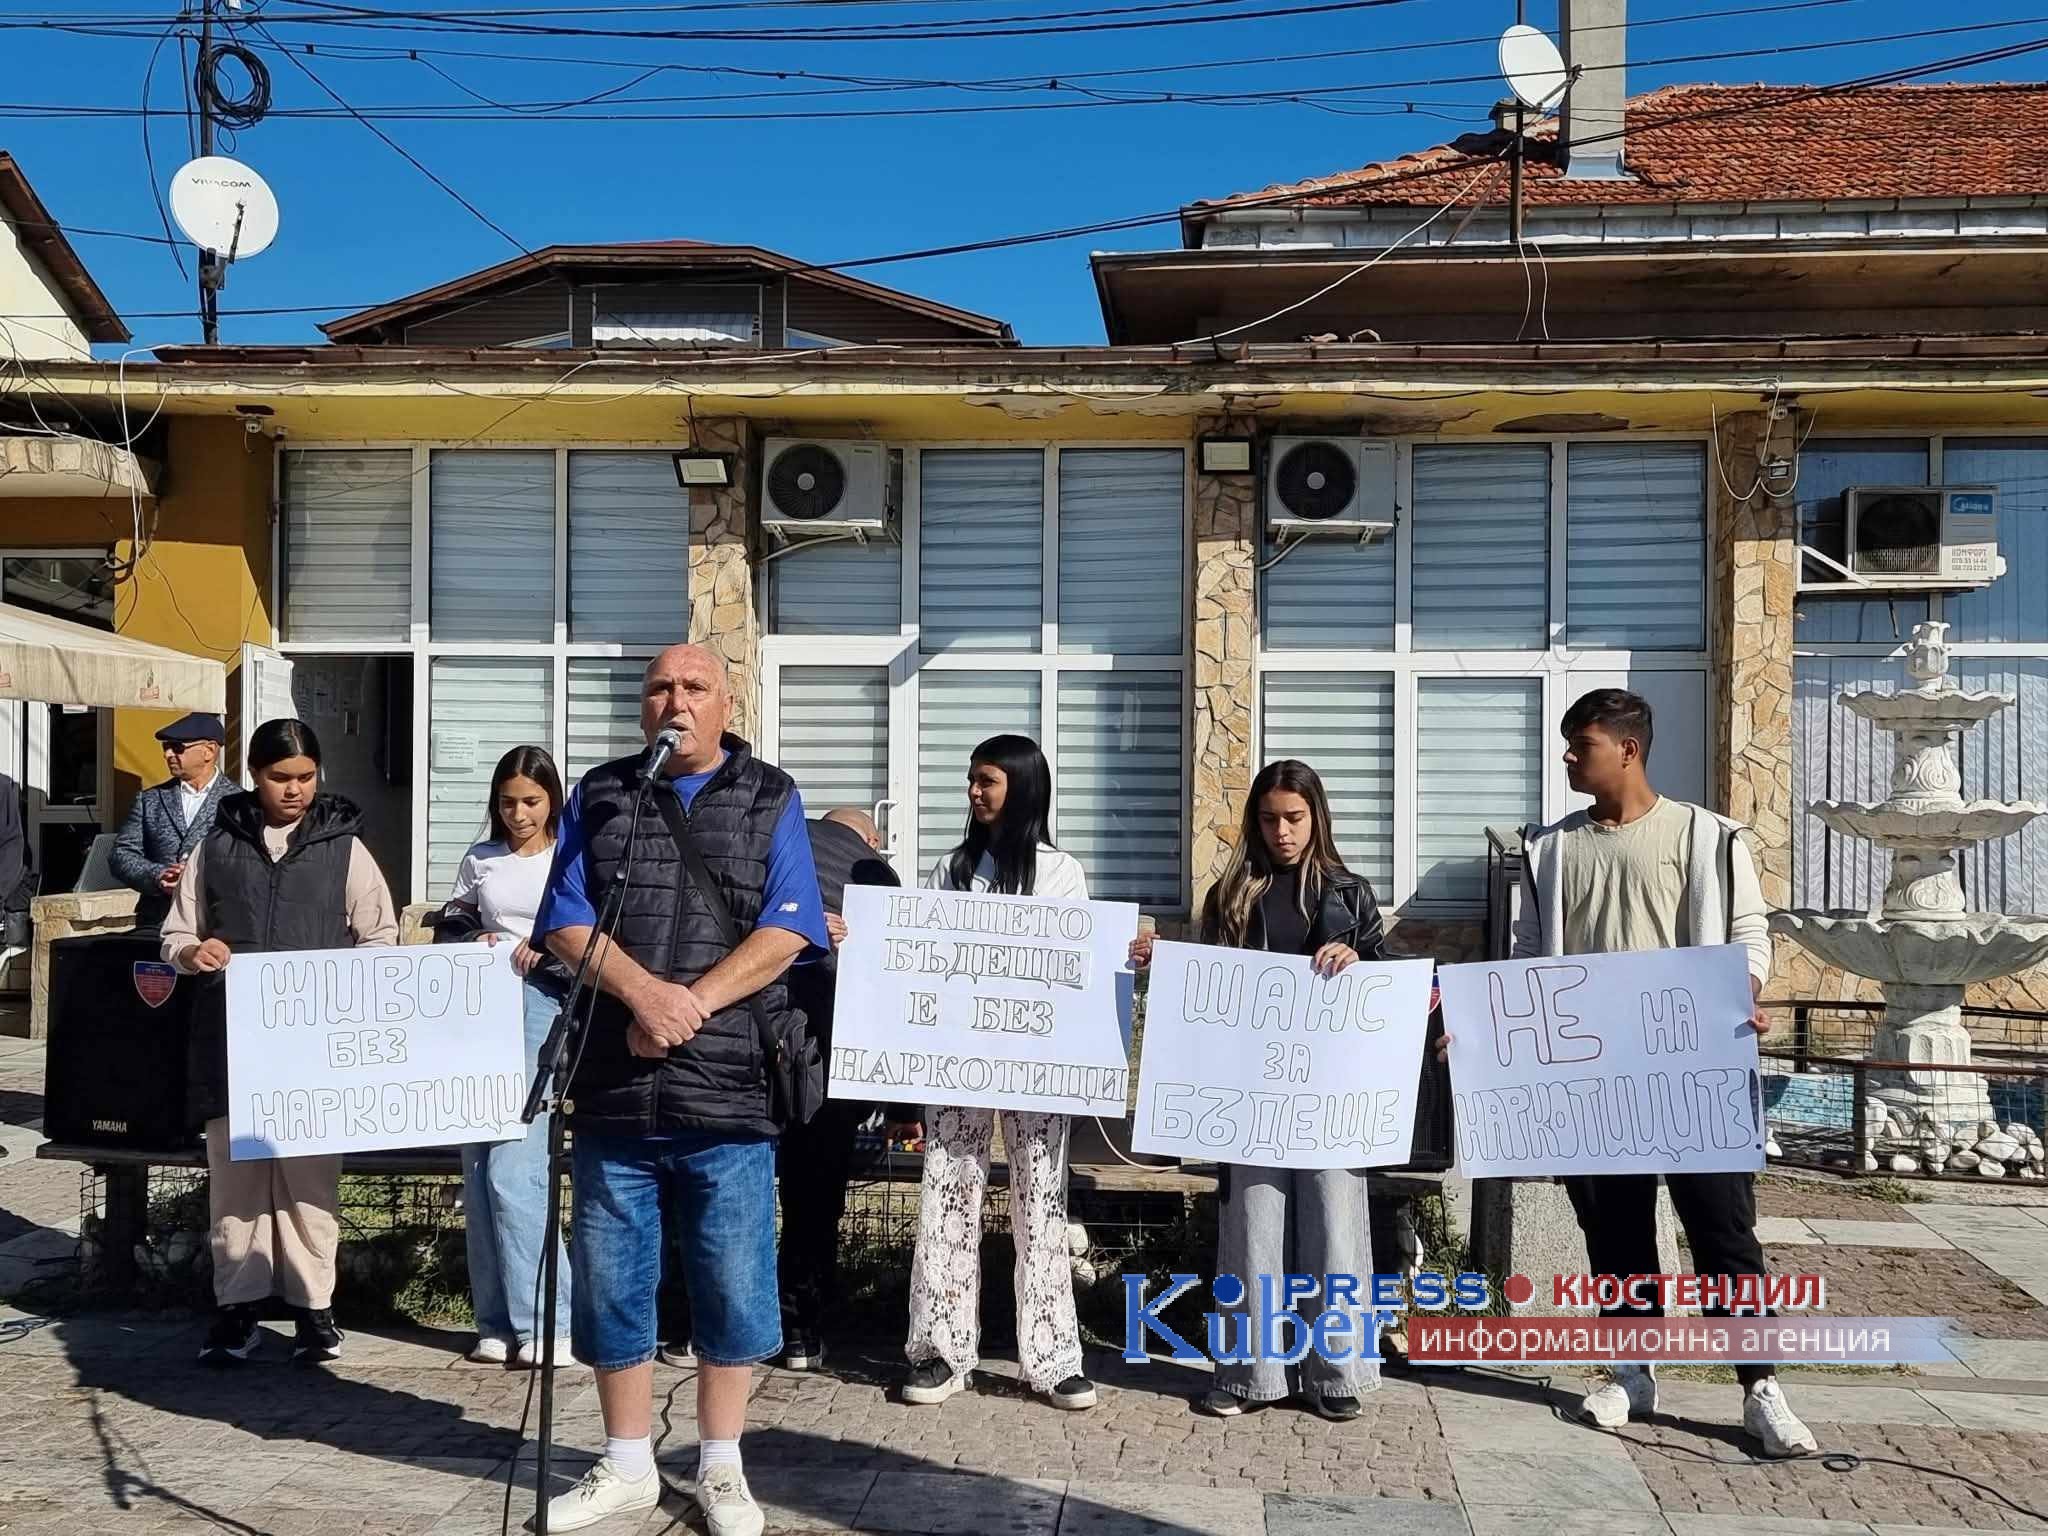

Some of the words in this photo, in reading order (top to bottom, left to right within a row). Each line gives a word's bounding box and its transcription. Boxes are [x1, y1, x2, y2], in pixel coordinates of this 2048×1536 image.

[885, 894, 1093, 941] НАШЕТО
[884, 938, 1083, 990] БЪДЕЩЕ
[260, 953, 495, 1029] ЖИВОТ
[908, 991, 937, 1026] Е
[971, 996, 1054, 1035] БЕЗ
[1183, 959, 1393, 1032] ШАНС
[1488, 965, 1602, 1067] НЕ
[1641, 987, 1698, 1055] НА
[327, 1027, 408, 1068] БЕЗ
[1263, 1041, 1311, 1083] ЗА
[831, 1047, 1127, 1106] НАРКОТИЦИ
[92, 1119, 127, 1132] YAMAHA
[251, 1072, 525, 1143] НАРКОТИЦИ
